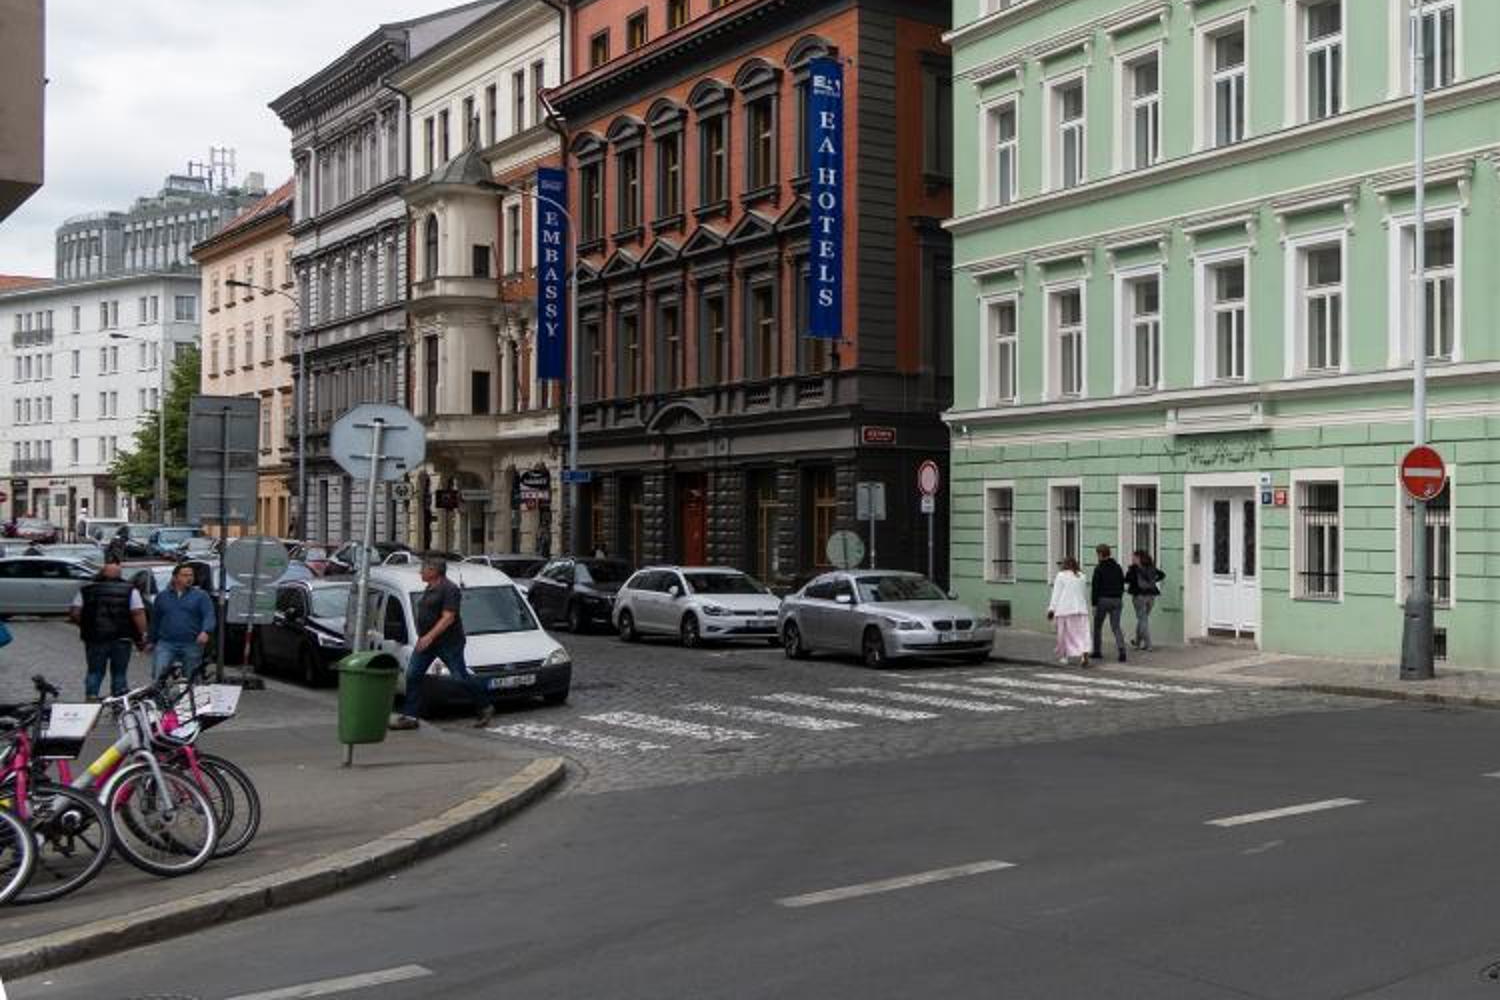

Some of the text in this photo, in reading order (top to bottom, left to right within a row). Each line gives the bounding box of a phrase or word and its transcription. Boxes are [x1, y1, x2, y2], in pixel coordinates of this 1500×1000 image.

[817, 111, 836, 153] EA
[543, 211, 561, 338] EMBASSY
[817, 167, 837, 307] HOTELS
